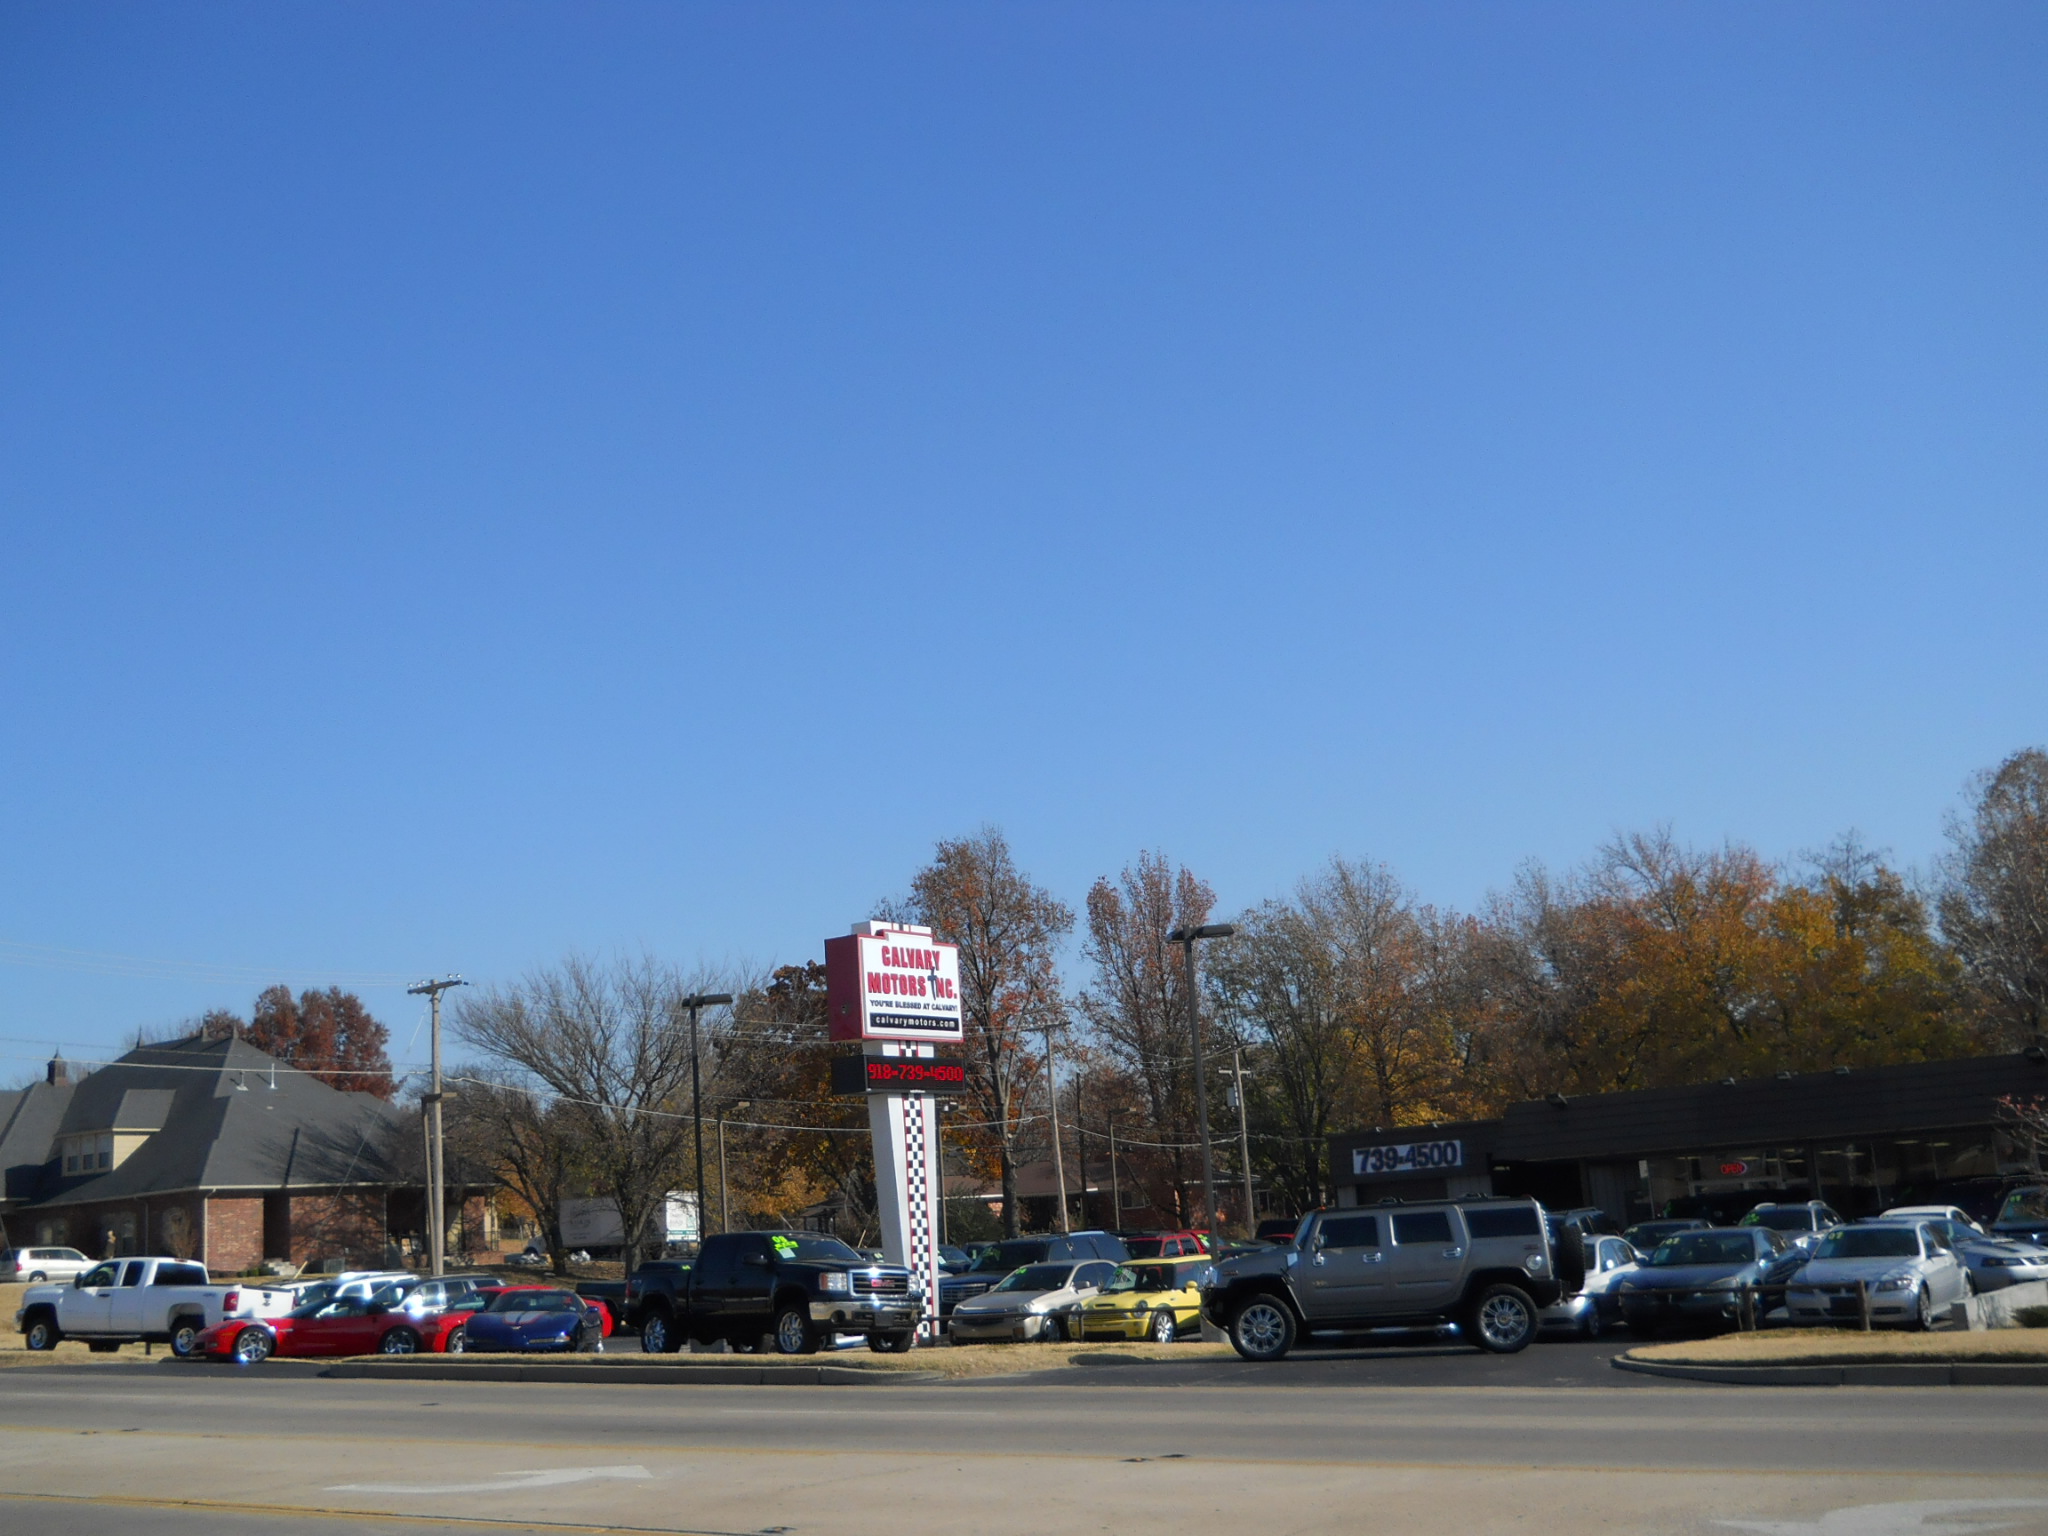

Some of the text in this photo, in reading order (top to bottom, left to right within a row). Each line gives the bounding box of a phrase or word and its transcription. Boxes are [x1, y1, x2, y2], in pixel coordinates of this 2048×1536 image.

[881, 945, 940, 971] CALVARY
[867, 971, 927, 997] MOTORS
[869, 999, 894, 1008] YOU'RE
[895, 1001, 922, 1010] BLESSED
[875, 1015, 956, 1028] calvarymotors.com
[867, 1063, 964, 1081] 918-739-4500
[1356, 1141, 1458, 1172] 739-4500
[1720, 1162, 1744, 1175] OPEN
